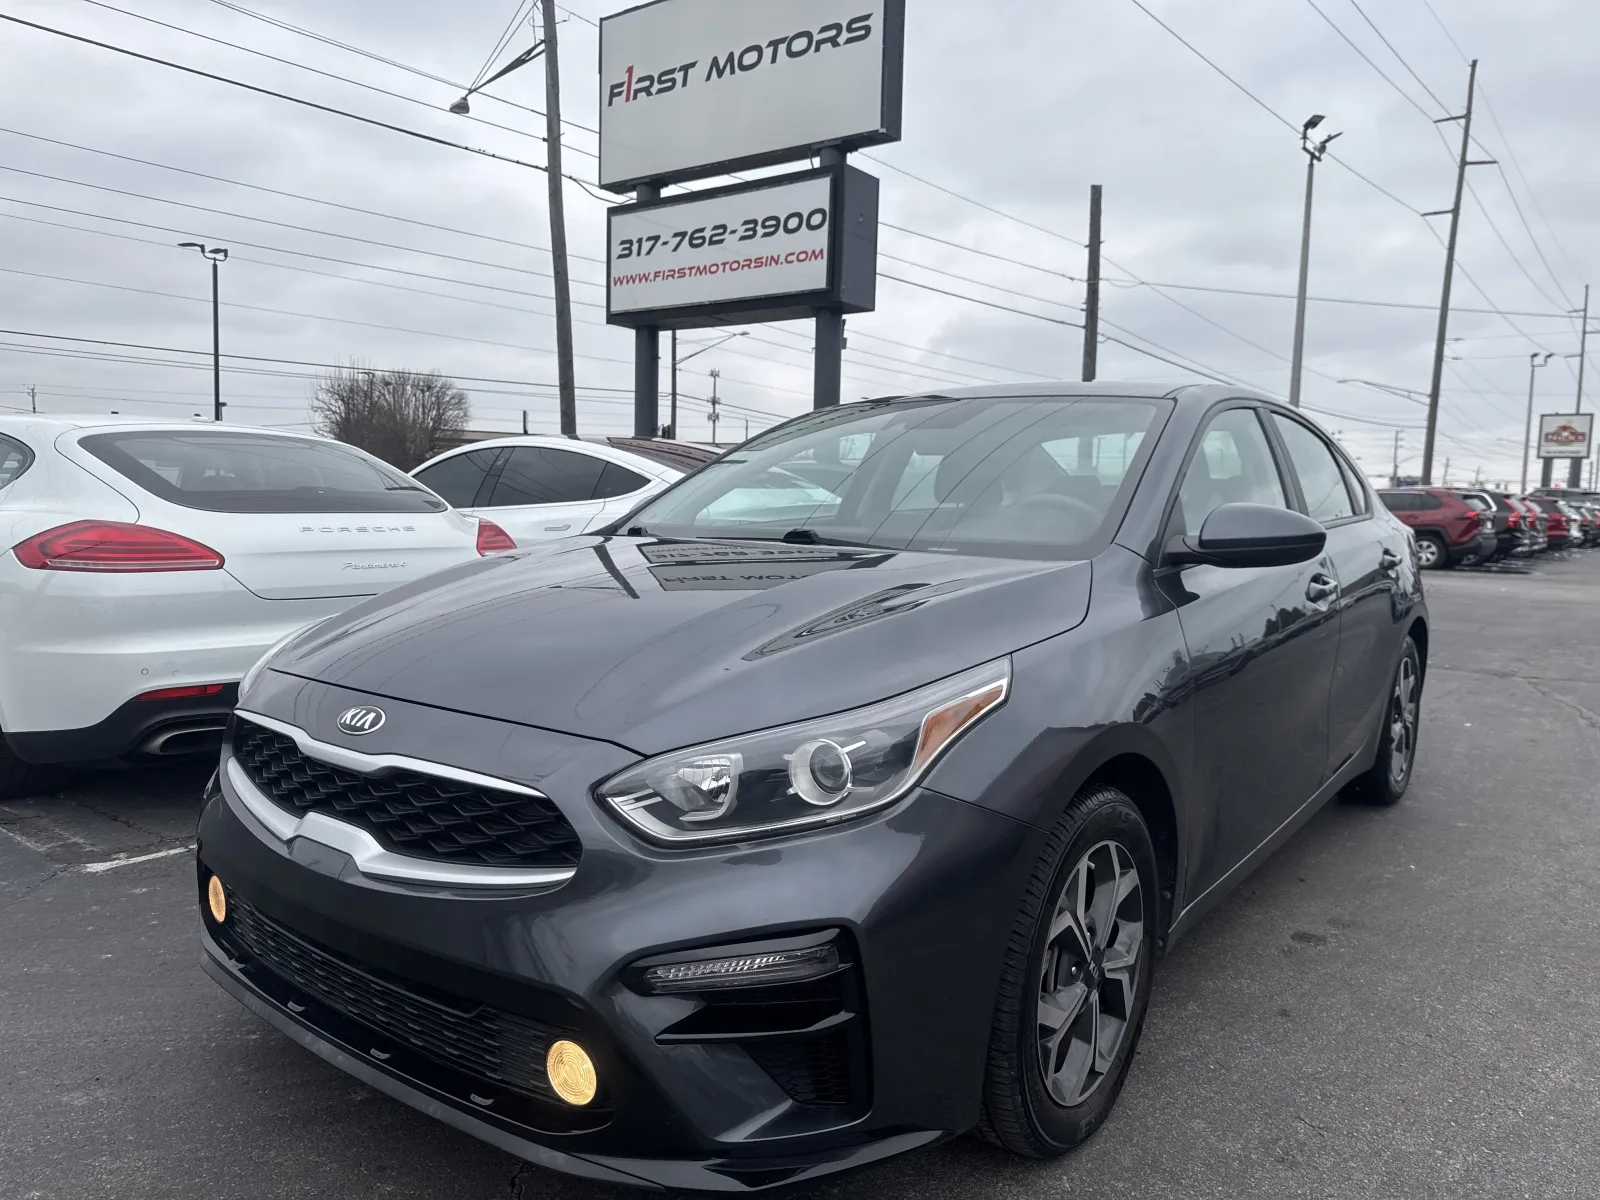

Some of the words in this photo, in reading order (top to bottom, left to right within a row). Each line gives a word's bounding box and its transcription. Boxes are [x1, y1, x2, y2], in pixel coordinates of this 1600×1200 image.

[705, 12, 874, 82] MOTORS
[616, 208, 828, 259] 317-762-3900
[613, 248, 825, 287] WWW.FIRSTMOTORSIN.COM
[300, 525, 416, 533] PORSCHE
[340, 708, 377, 730] KIA
